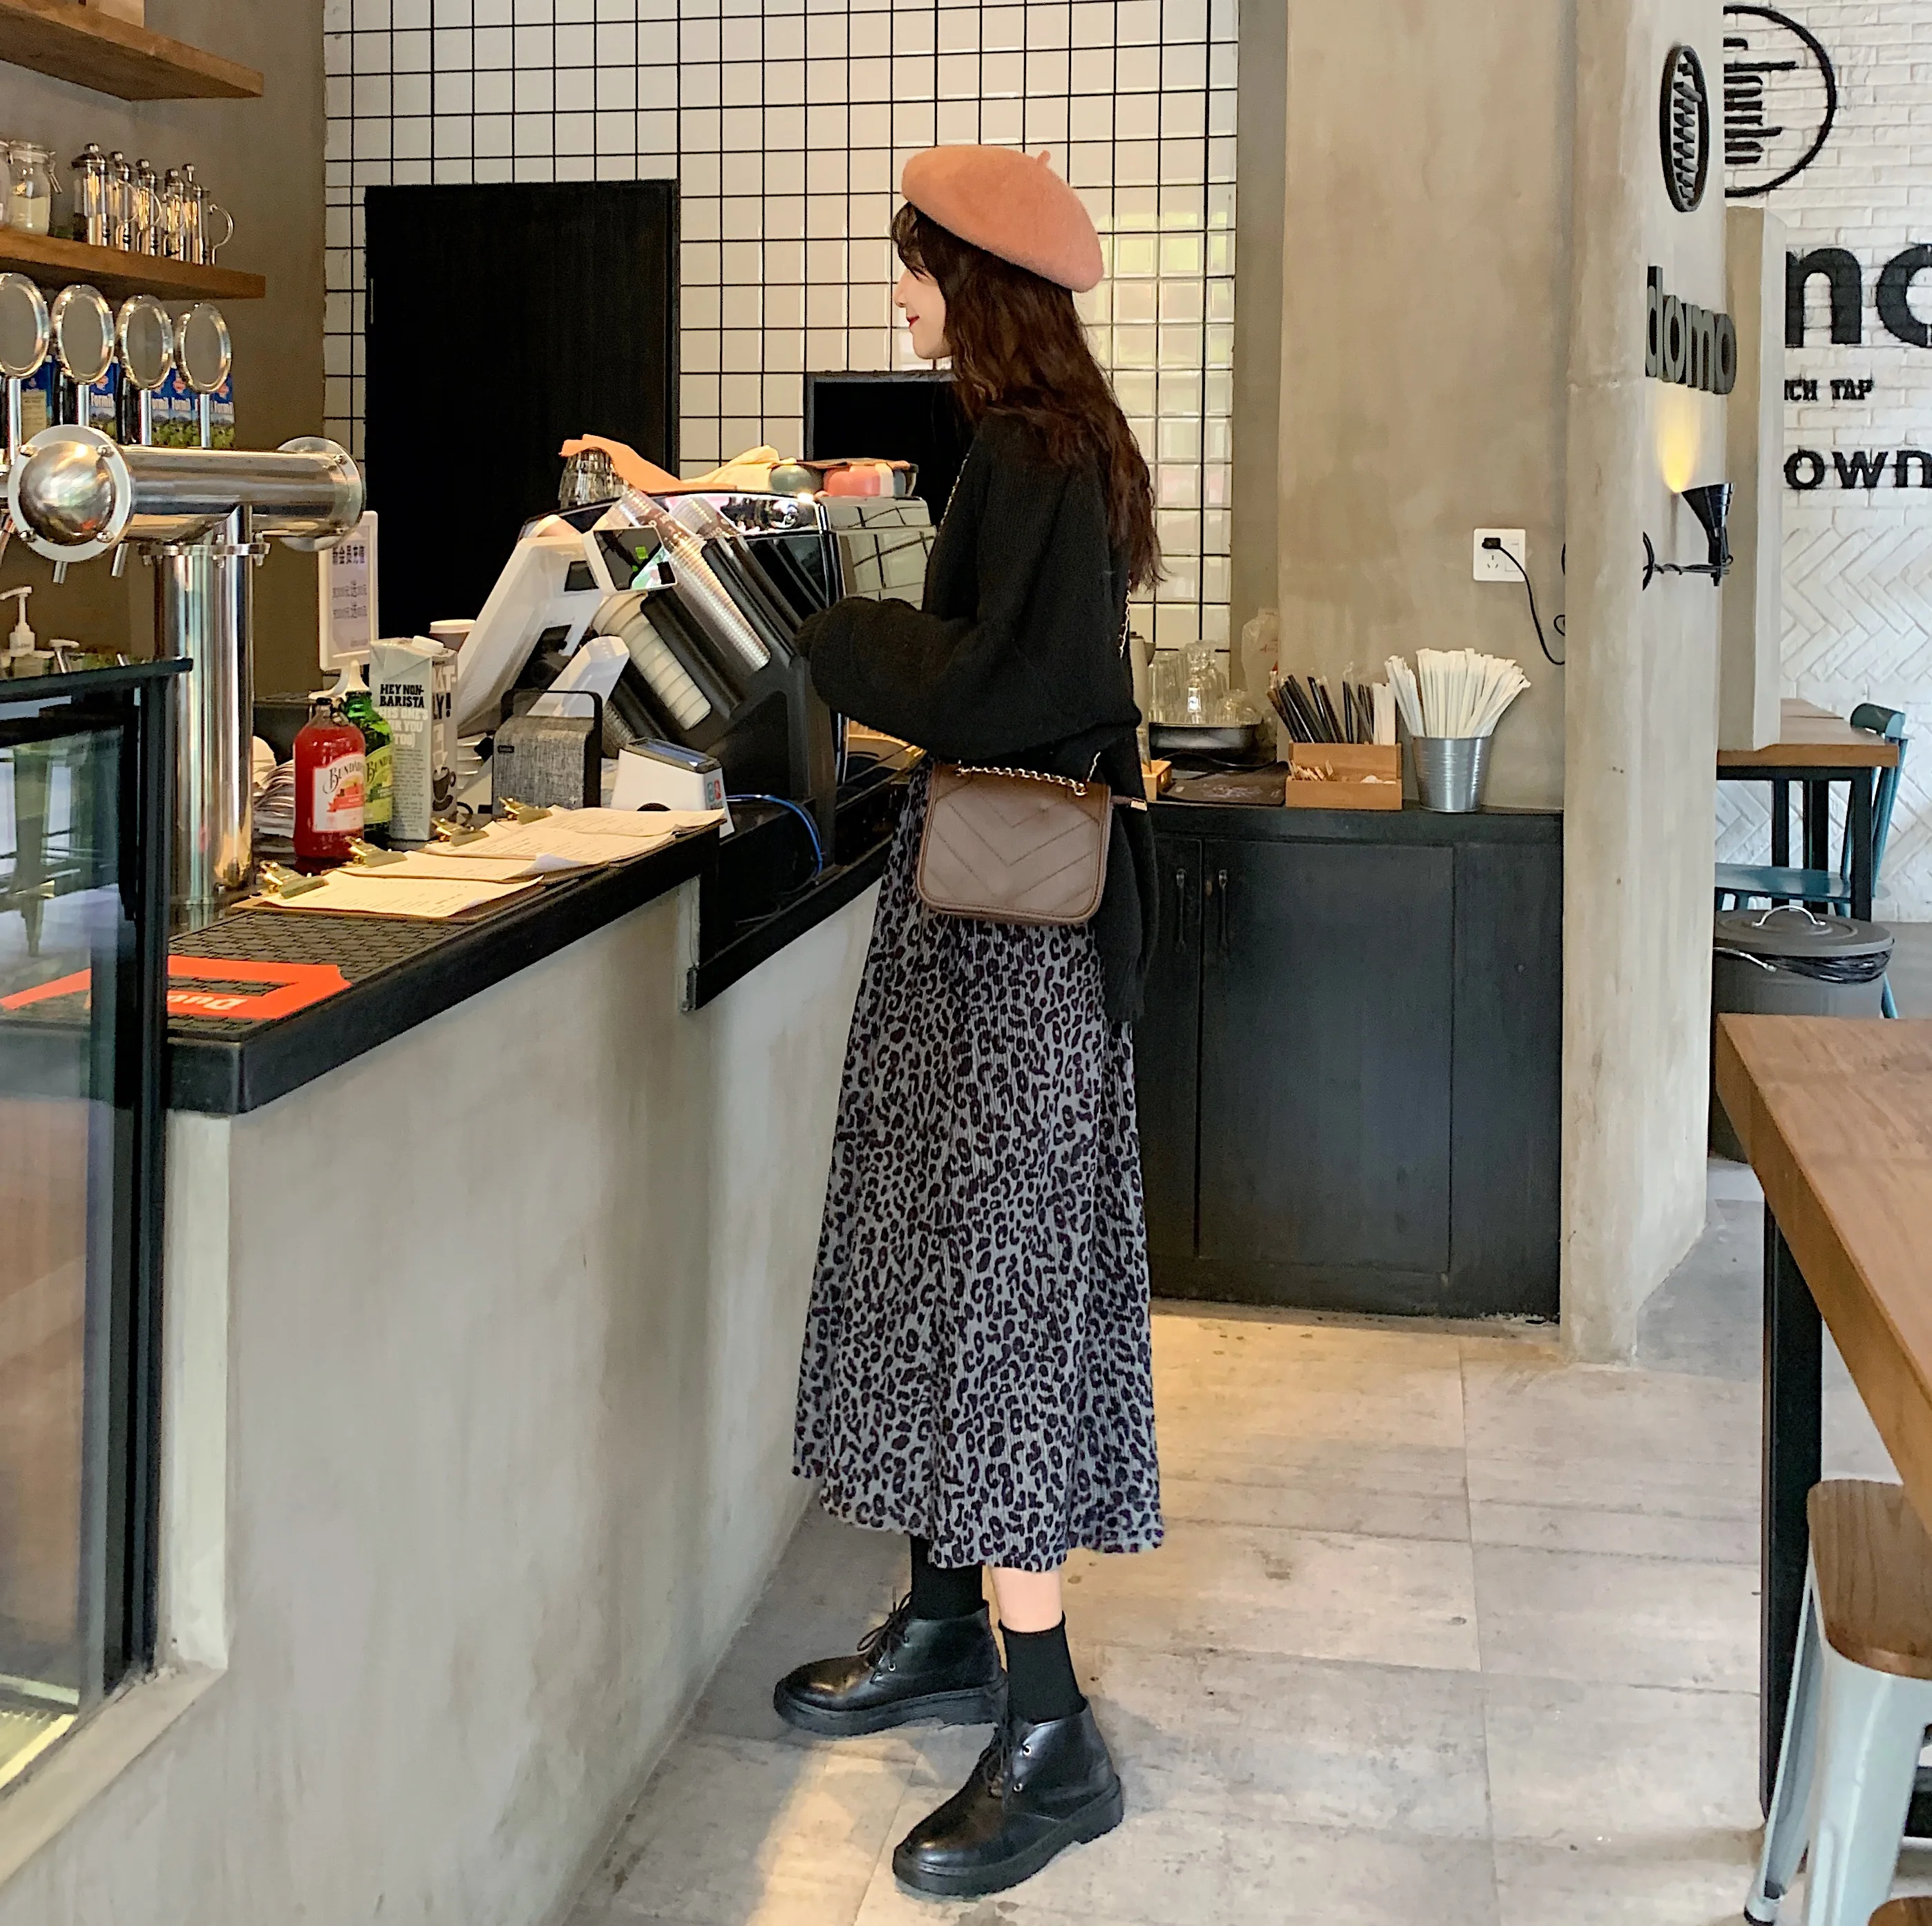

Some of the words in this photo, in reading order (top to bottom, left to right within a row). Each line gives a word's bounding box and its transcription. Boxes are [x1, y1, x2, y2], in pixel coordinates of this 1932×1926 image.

[1645, 265, 1737, 395] domo
[1830, 379, 1873, 400] TAP
[381, 684, 401, 695] HEY
[403, 685, 424, 696] NON-
[379, 696, 425, 708] BARISTA
[401, 707, 428, 721] ONE'S
[404, 721, 424, 733] YOU
